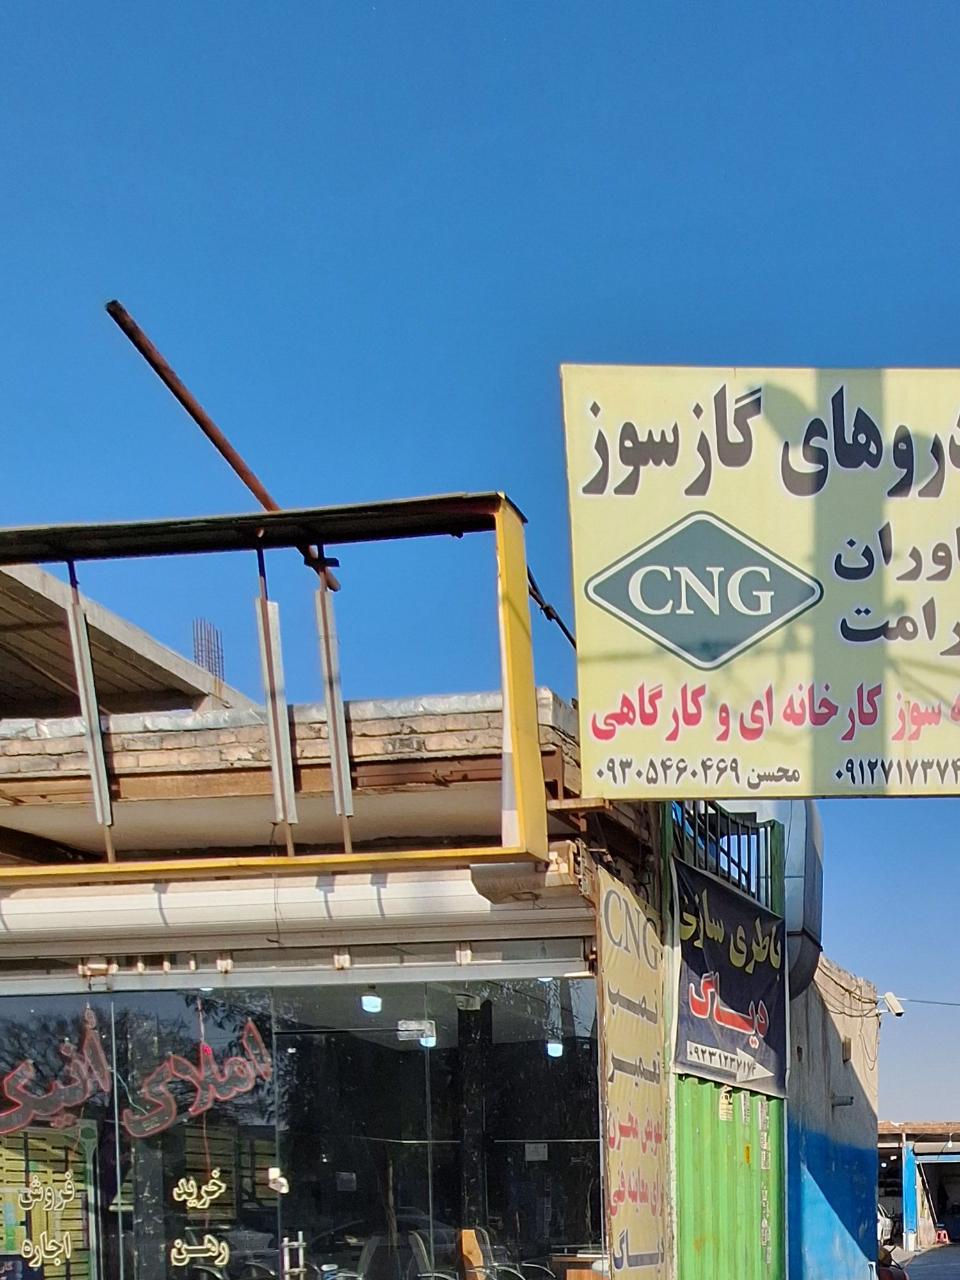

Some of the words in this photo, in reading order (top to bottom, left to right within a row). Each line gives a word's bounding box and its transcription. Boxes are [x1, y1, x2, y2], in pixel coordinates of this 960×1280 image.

[627, 564, 775, 618] CNG
[591, 681, 707, 741] کارگاهی
[716, 702, 732, 741] و
[739, 683, 774, 741] ای
[782, 681, 883, 741] کارخانه
[891, 690, 942, 741] سوز
[597, 757, 740, 784] ۰۹۳۰۵۴۶۰۴۶۹
[746, 765, 801, 790] محسن
[603, 888, 659, 971] CNG
[730, 917, 782, 983] باطری
[608, 979, 658, 1025] نصب
[607, 1050, 661, 1089] تعمیر
[18, 1170, 76, 1211] فروش
[173, 1167, 227, 1209] خرید
[21, 1231, 72, 1268] اجاره
[170, 1234, 230, 1266] رهن
